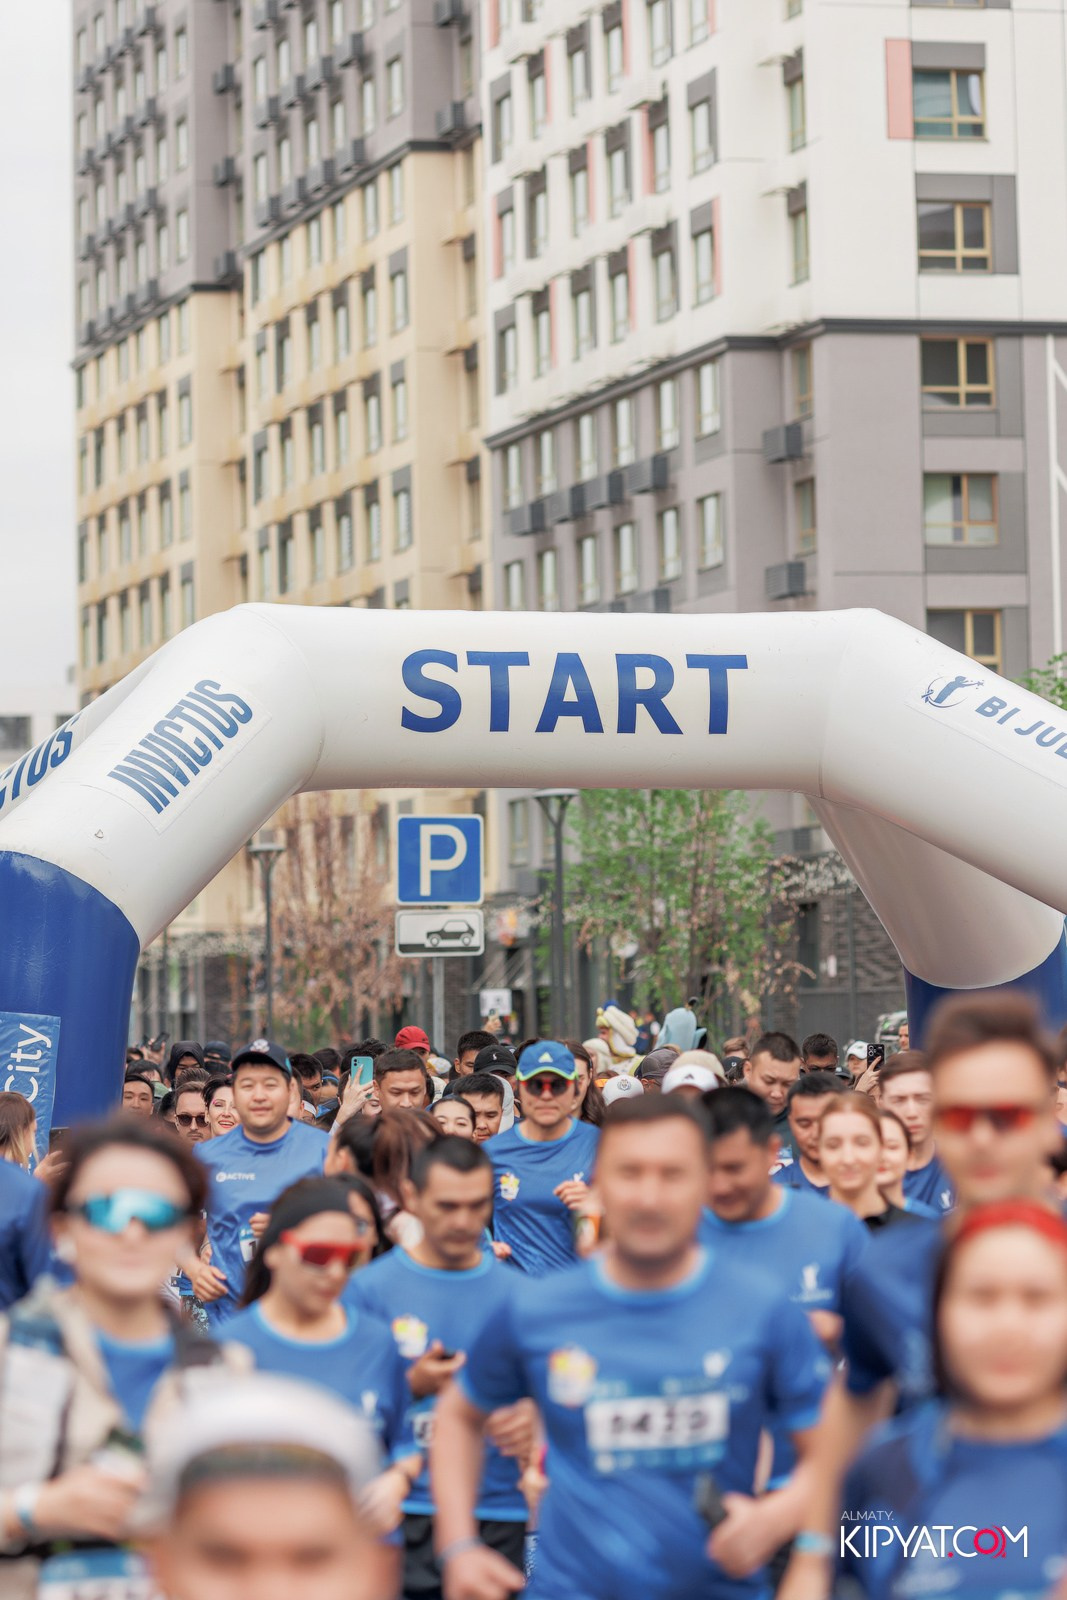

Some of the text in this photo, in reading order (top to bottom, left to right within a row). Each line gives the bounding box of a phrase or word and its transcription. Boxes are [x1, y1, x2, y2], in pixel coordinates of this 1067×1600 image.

[401, 649, 748, 734] START
[975, 696, 1021, 725] BI
[107, 679, 253, 814] INVICTUS
[420, 824, 467, 896] P
[4, 1023, 51, 1103] City
